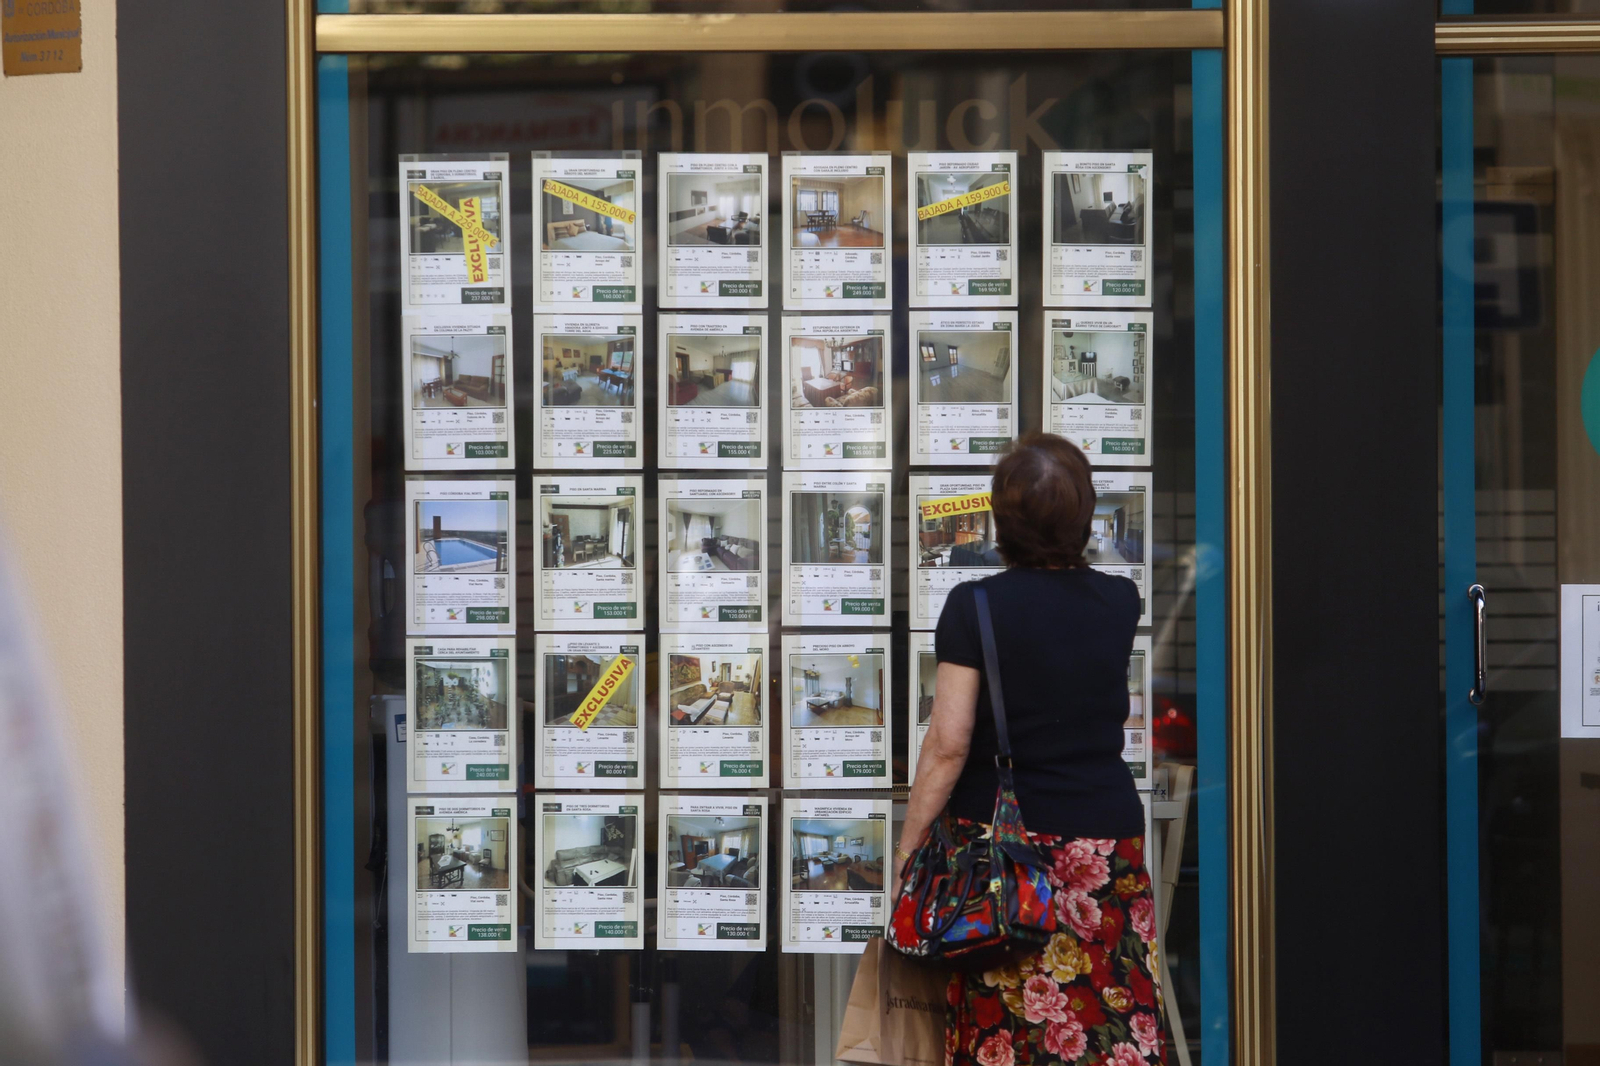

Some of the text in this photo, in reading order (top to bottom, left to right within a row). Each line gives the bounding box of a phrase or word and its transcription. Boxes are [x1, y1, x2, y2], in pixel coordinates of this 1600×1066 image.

[611, 71, 1062, 156] inmoluck
[416, 187, 448, 213] BAJADA
[456, 215, 489, 242] 229.000
[490, 239, 497, 248] €
[545, 182, 636, 222] BAJADA A 155.000 €
[918, 184, 1010, 219] BAJADA A 159.900 €
[574, 658, 632, 728] EXCLUSIVA
